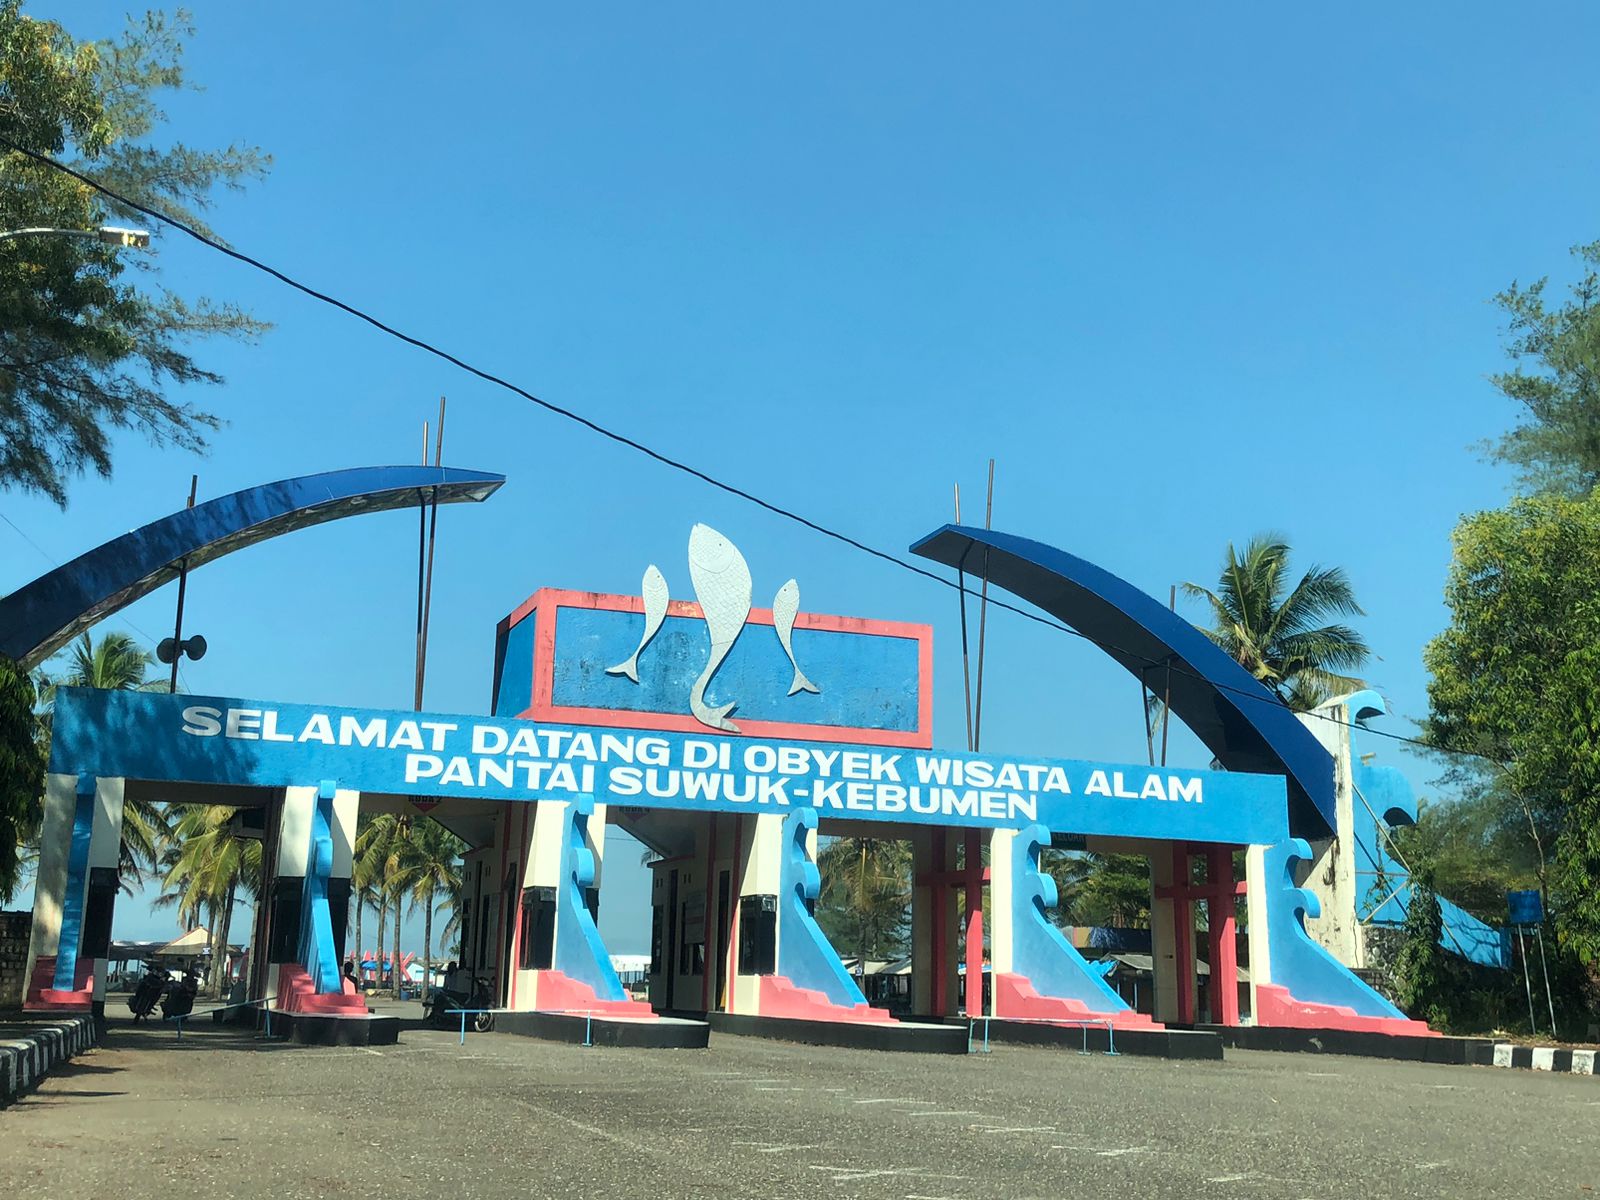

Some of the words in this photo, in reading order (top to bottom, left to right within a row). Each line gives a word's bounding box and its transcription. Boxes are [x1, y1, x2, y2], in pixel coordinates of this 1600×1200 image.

[183, 707, 457, 751] SELAMAT
[472, 726, 670, 766] DATANG
[684, 741, 730, 769] DI
[744, 746, 901, 781] OBYEK
[916, 757, 1070, 793] WISATA
[1085, 771, 1202, 802] ALAM
[406, 754, 594, 792] PANTAI
[609, 767, 1036, 820] SUWUK-KEBUMEN
